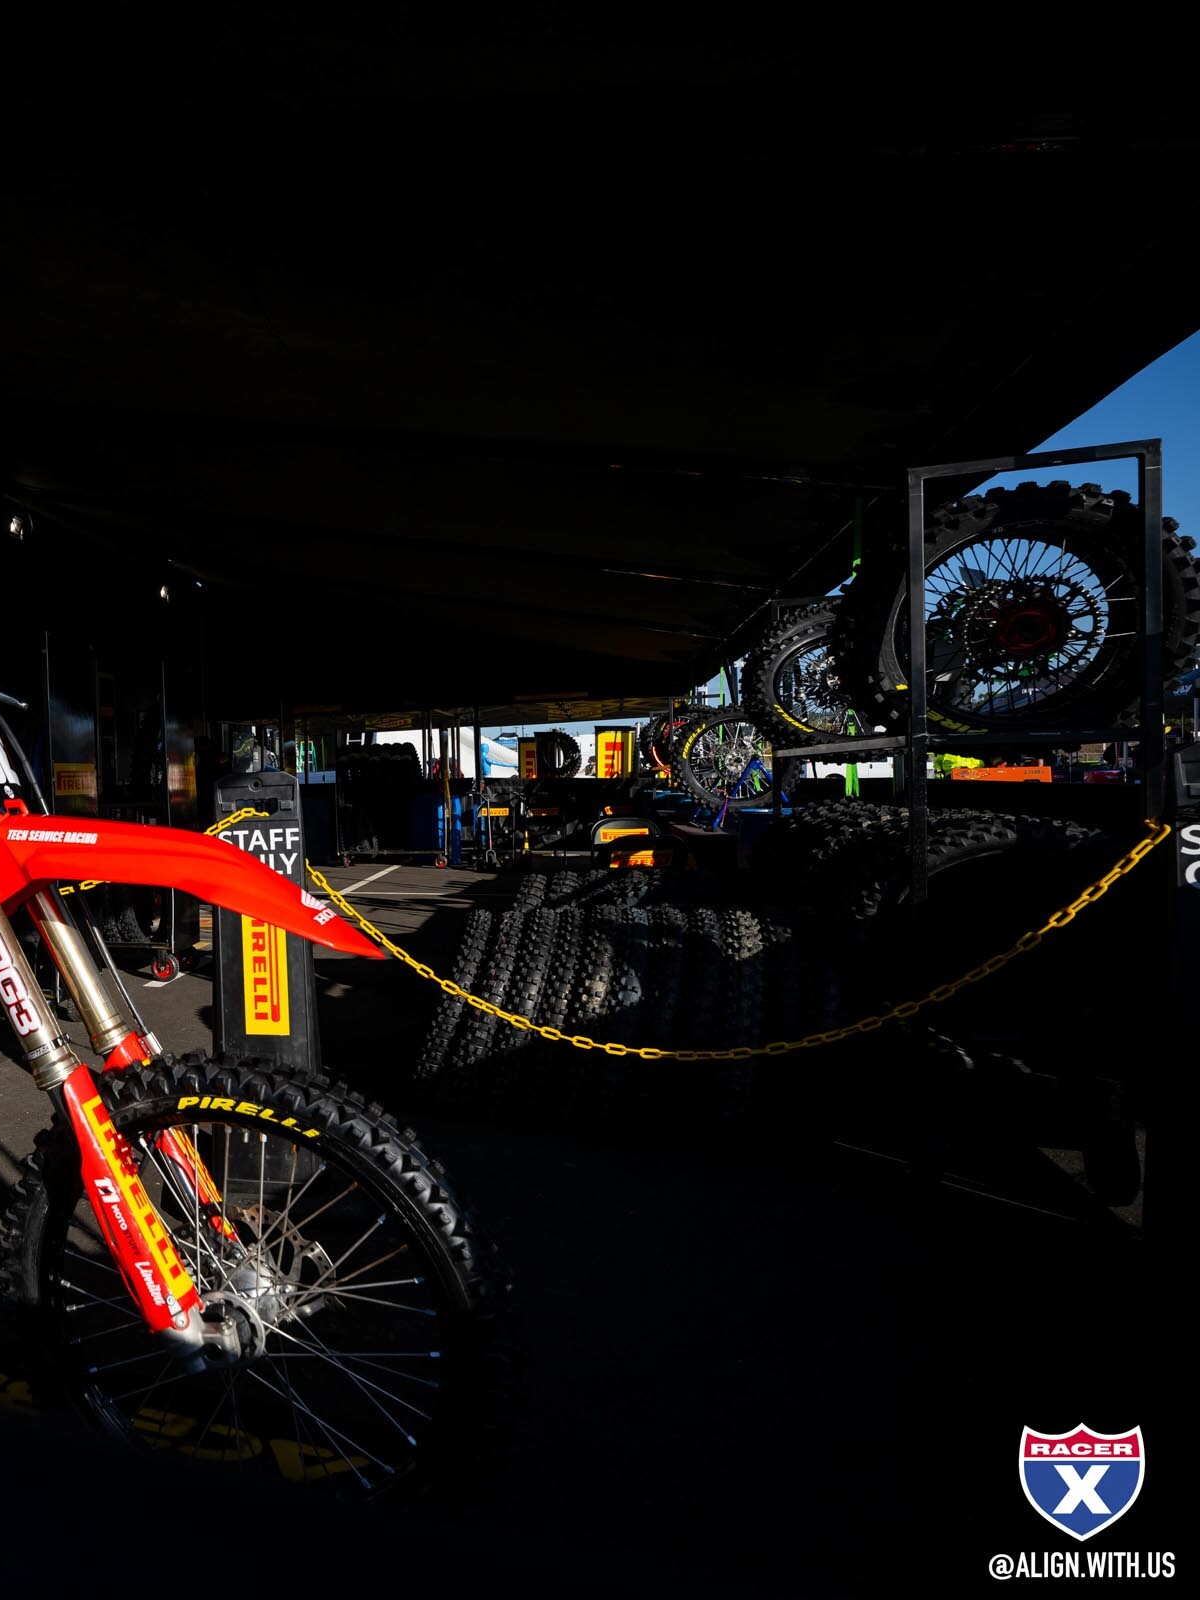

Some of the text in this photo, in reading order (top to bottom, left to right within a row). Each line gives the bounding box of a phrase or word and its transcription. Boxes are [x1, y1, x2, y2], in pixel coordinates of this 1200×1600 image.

[6, 829, 98, 845] TECH SERVICE RACING
[259, 853, 298, 875] LY
[250, 916, 281, 1023] IRELLI
[177, 1096, 321, 1139] PIRELLI
